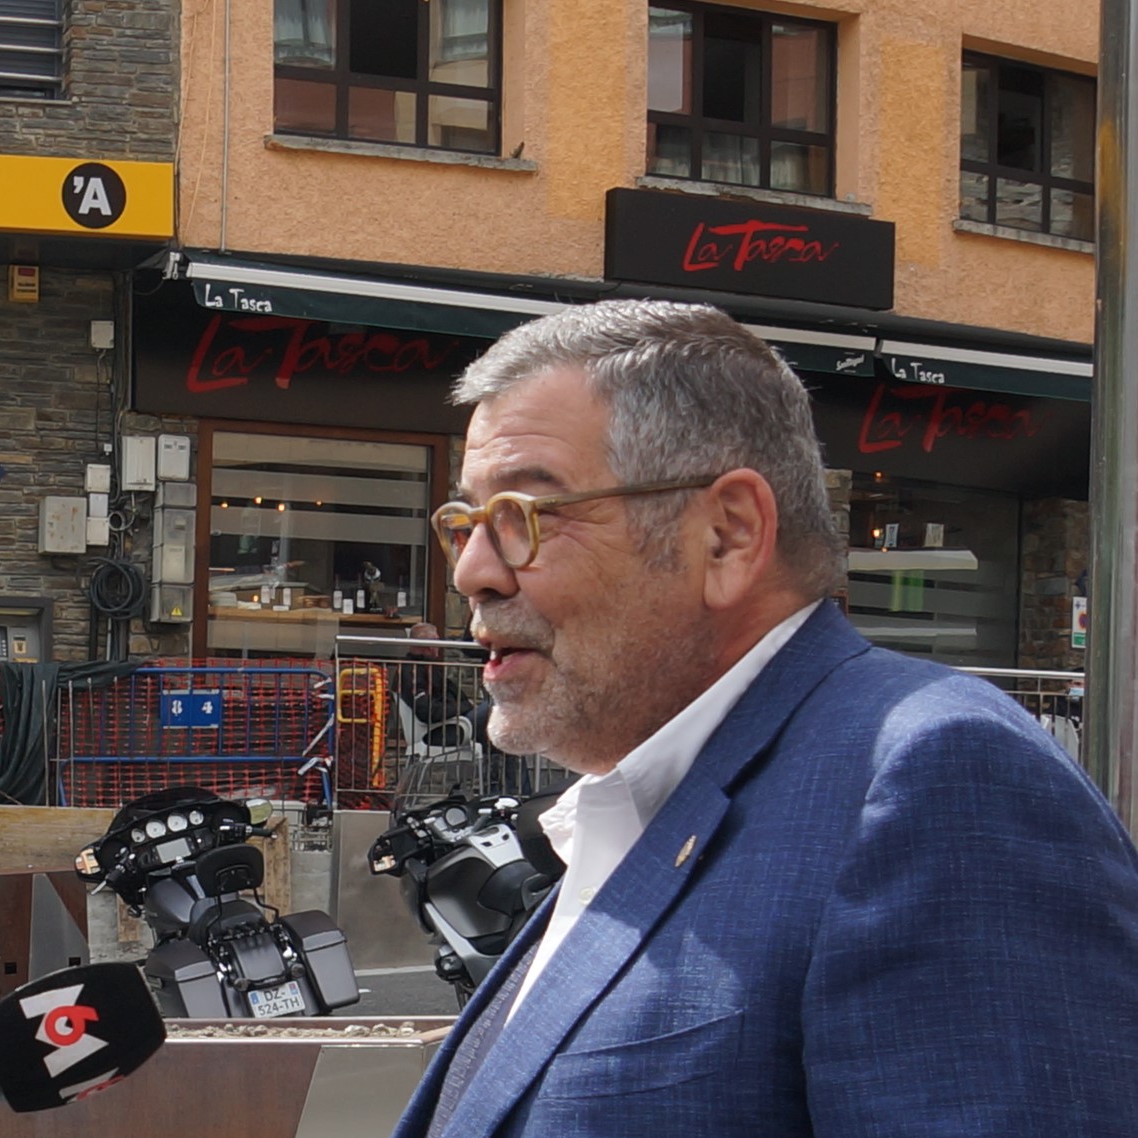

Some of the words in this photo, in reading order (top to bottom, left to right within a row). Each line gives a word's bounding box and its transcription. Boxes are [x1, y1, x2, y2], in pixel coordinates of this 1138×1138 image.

[682, 222, 728, 272] La
[205, 284, 223, 308] La
[229, 288, 272, 313] Tasca
[186, 315, 265, 393] La
[229, 316, 456, 390] Tasca
[891, 358, 907, 379] La
[910, 361, 946, 384] Tasca
[857, 384, 908, 454] La
[201, 701, 213, 714] 4
[257, 996, 300, 1016] 524-TH
